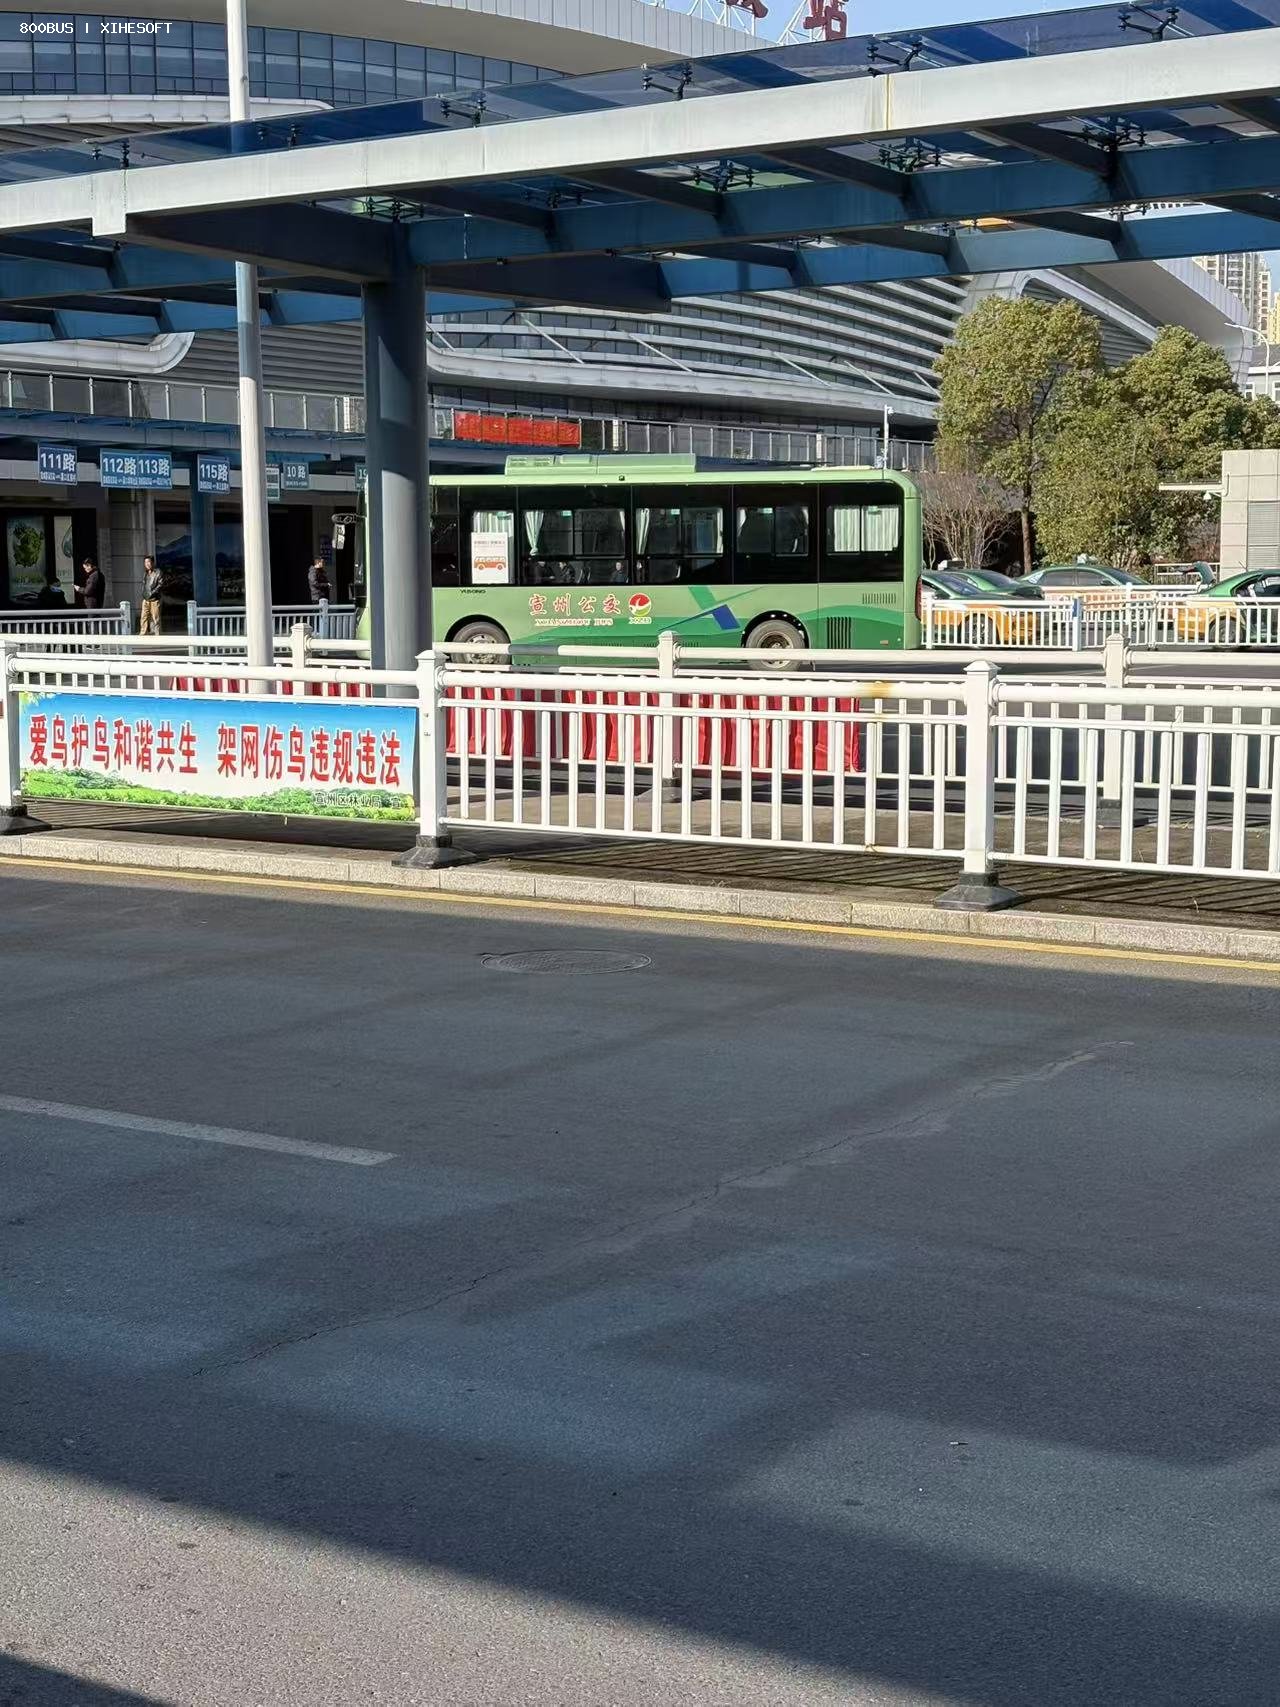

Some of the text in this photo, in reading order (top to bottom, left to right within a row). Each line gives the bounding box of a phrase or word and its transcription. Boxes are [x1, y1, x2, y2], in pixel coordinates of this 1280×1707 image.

[40, 452, 76, 472] 111路
[102, 456, 137, 475] 112路
[138, 458, 170, 476] 113路
[200, 463, 229, 482] 115路
[528, 592, 622, 616] 宣州公交
[28, 713, 402, 788] 爱鸟护鸟和谐共生 架网伤鸟违规违法
[314, 792, 382, 809] 宣州区林业局
